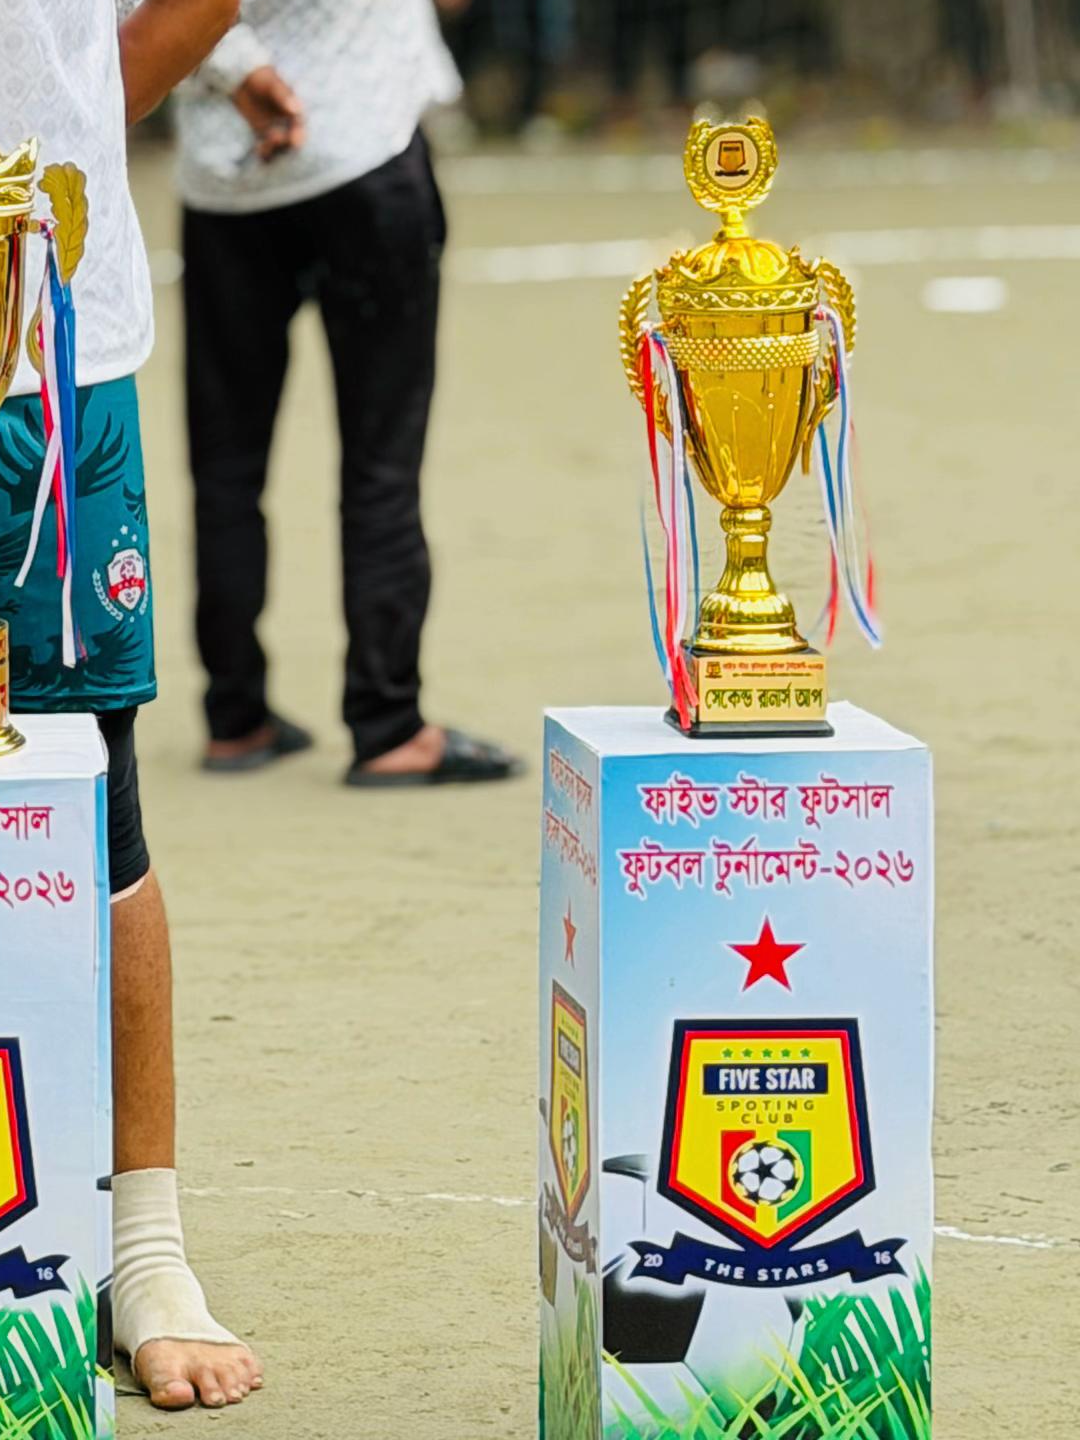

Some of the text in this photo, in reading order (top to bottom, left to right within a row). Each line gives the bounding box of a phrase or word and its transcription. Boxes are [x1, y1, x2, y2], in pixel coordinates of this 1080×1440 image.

[705, 681, 823, 709] সেকেন্ড রানার্স আপ
[641, 772, 720, 825] ফাইভ
[729, 772, 788, 820] স্টার
[798, 773, 894, 829] ফুটসাল
[621, 840, 705, 896] ফুটবল
[713, 836, 914, 896] টুর্নামেন্ট-২০২৬
[719, 1067, 816, 1090] FIVE STAR
[716, 1099, 815, 1111] SPOTING
[741, 1112, 794, 1124] CLUB
[643, 1253, 663, 1267] 20
[874, 1252, 891, 1265] 16
[36, 1267, 54, 1281] 16
[704, 1259, 829, 1281] THE STARS
